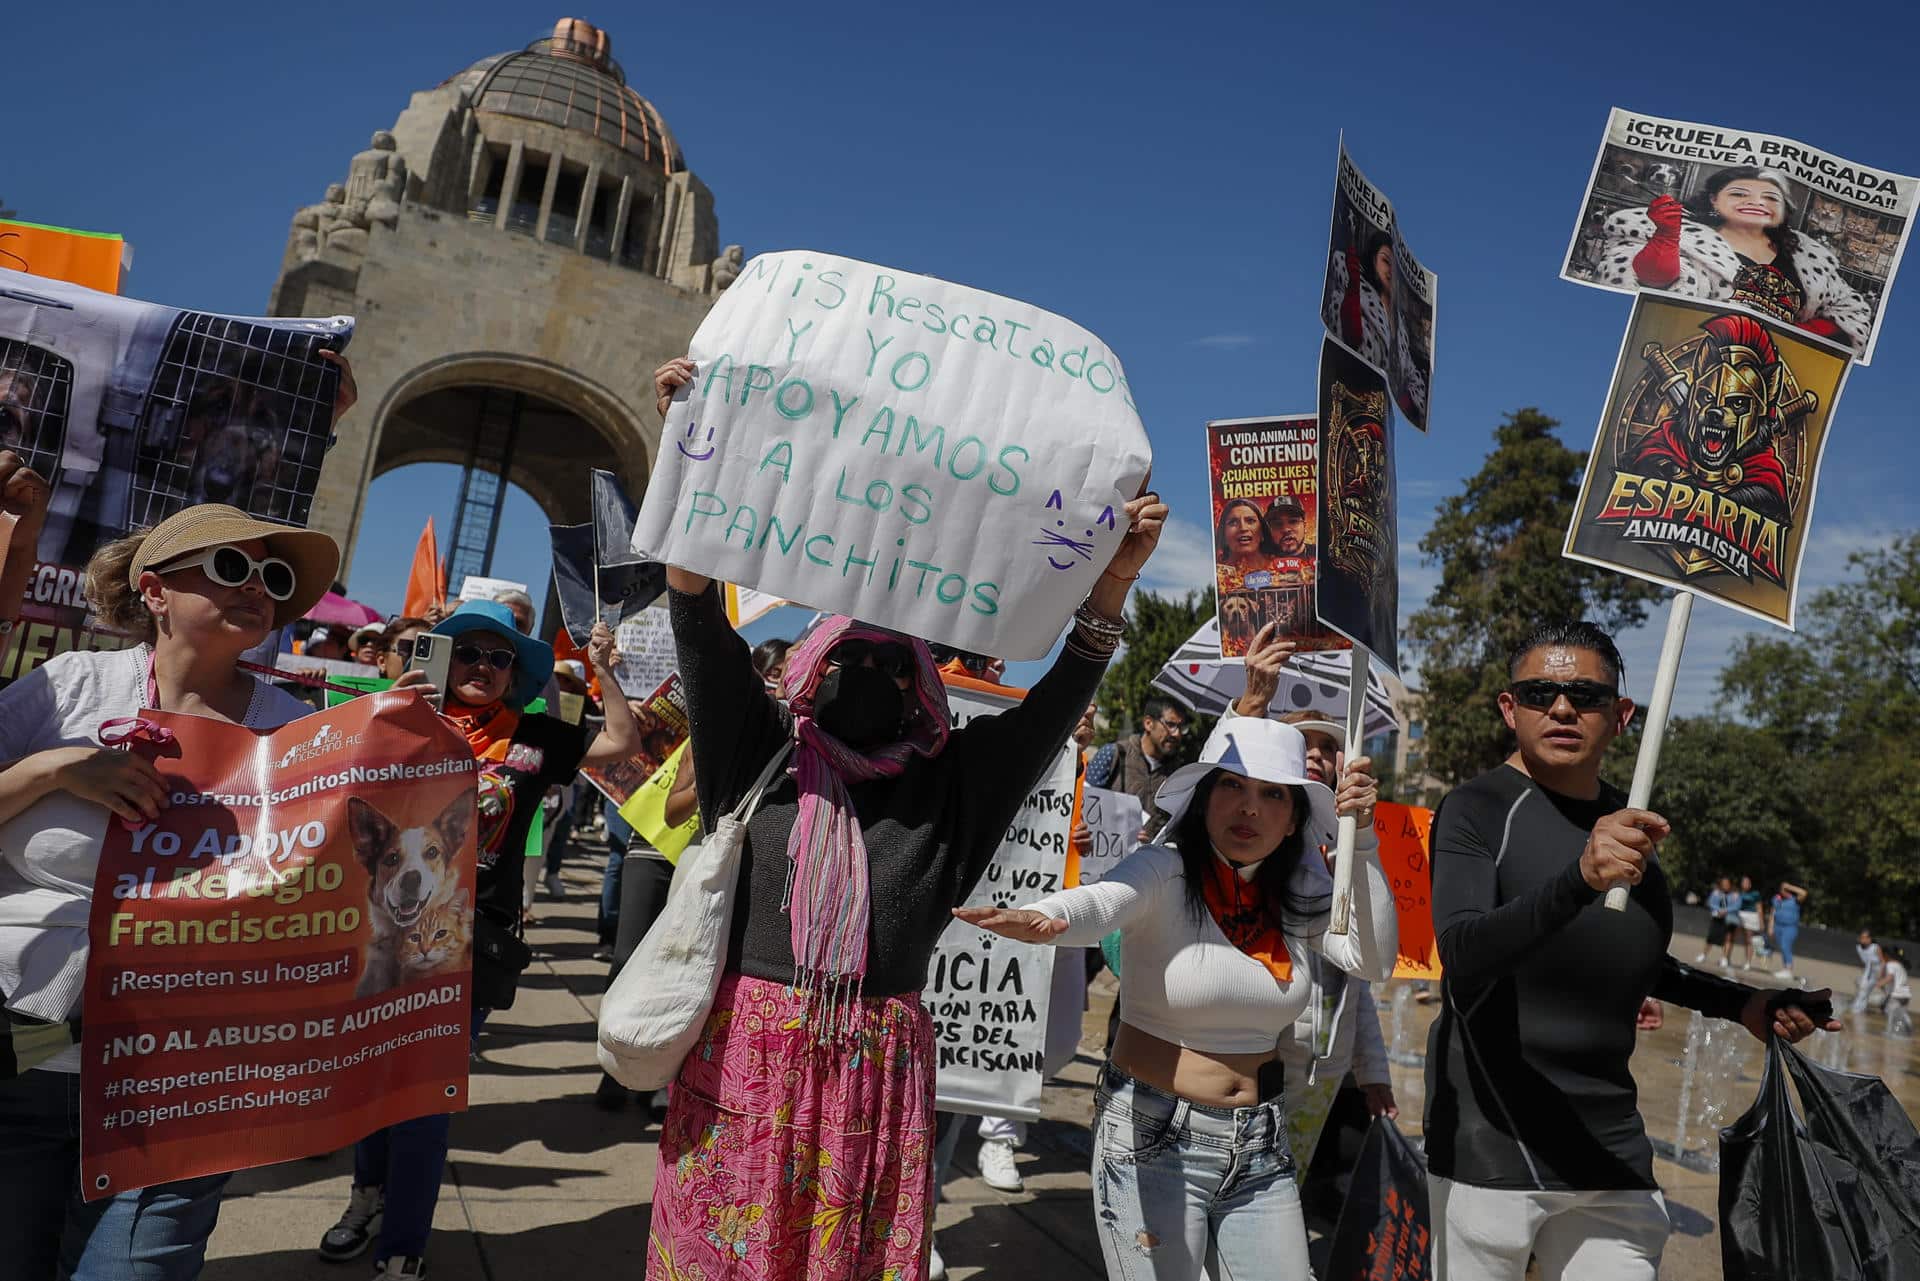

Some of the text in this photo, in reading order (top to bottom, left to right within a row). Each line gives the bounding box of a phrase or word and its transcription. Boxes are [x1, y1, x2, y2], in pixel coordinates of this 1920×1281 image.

[1626, 118, 1899, 196] ¡CRUELA BRUGADA
[1626, 135, 1898, 210] DEVUELVE A LA MANADA!!
[787, 318, 931, 392] Y YO
[702, 353, 1030, 497] APOYAMOS
[1220, 427, 1316, 446] LA VIDA ANIMAL NO
[759, 440, 793, 485] A
[1221, 466, 1278, 484] ¿CUÁNTOS
[1278, 465, 1309, 479] LIKES
[834, 466, 933, 525] LOS
[1223, 480, 1289, 499] HABERTE
[1595, 470, 1788, 579] ESPARTA
[1623, 519, 1750, 577] ANIMALISTA
[171, 756, 474, 807] osFranciscanitosNosNecesitan
[129, 820, 327, 867] Yo Apoyo
[1005, 825, 1065, 855] DOLOR
[113, 858, 344, 904] al Refugio
[1012, 868, 1058, 893] VOZ
[108, 905, 361, 947] Franciscano
[111, 955, 350, 996] ¡Respeten su hogar!
[934, 947, 1024, 996] ICIA
[102, 984, 463, 1065] ¡NO AL ABUSO DE AUTORIDAD!
[922, 992, 1036, 1023] IÓN PARA
[973, 1024, 1020, 1048] DEL
[104, 1021, 462, 1099] #RespetenElHogarDeLosFranciscanitos
[102, 1083, 333, 1130] #DejenLosEnSuHogar
